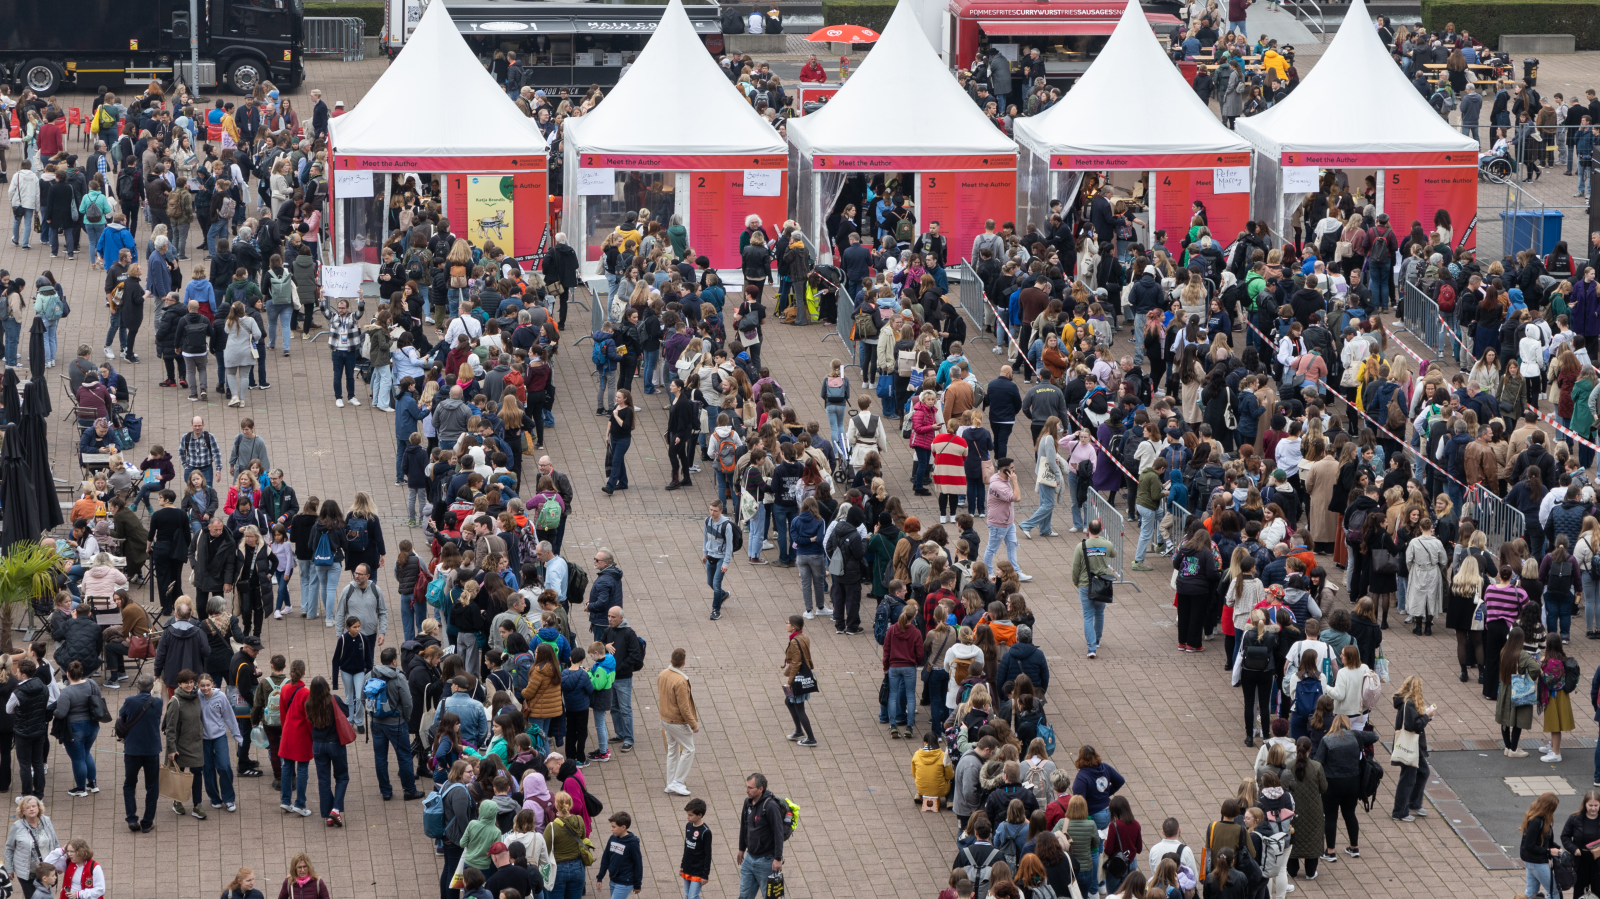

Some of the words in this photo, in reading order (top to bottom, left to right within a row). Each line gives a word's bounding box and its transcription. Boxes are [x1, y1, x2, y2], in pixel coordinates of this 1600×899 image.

[343, 159, 348, 167] 1
[587, 157, 593, 165] 2
[820, 158, 825, 166] 3
[1056, 158, 1063, 166] 4
[1288, 156, 1294, 164] 5
[454, 178, 460, 189] 1
[697, 177, 705, 188] 2
[928, 177, 936, 188] 3
[1163, 175, 1171, 187] 4
[1392, 174, 1400, 185] 5
[324, 267, 347, 278] Marie
